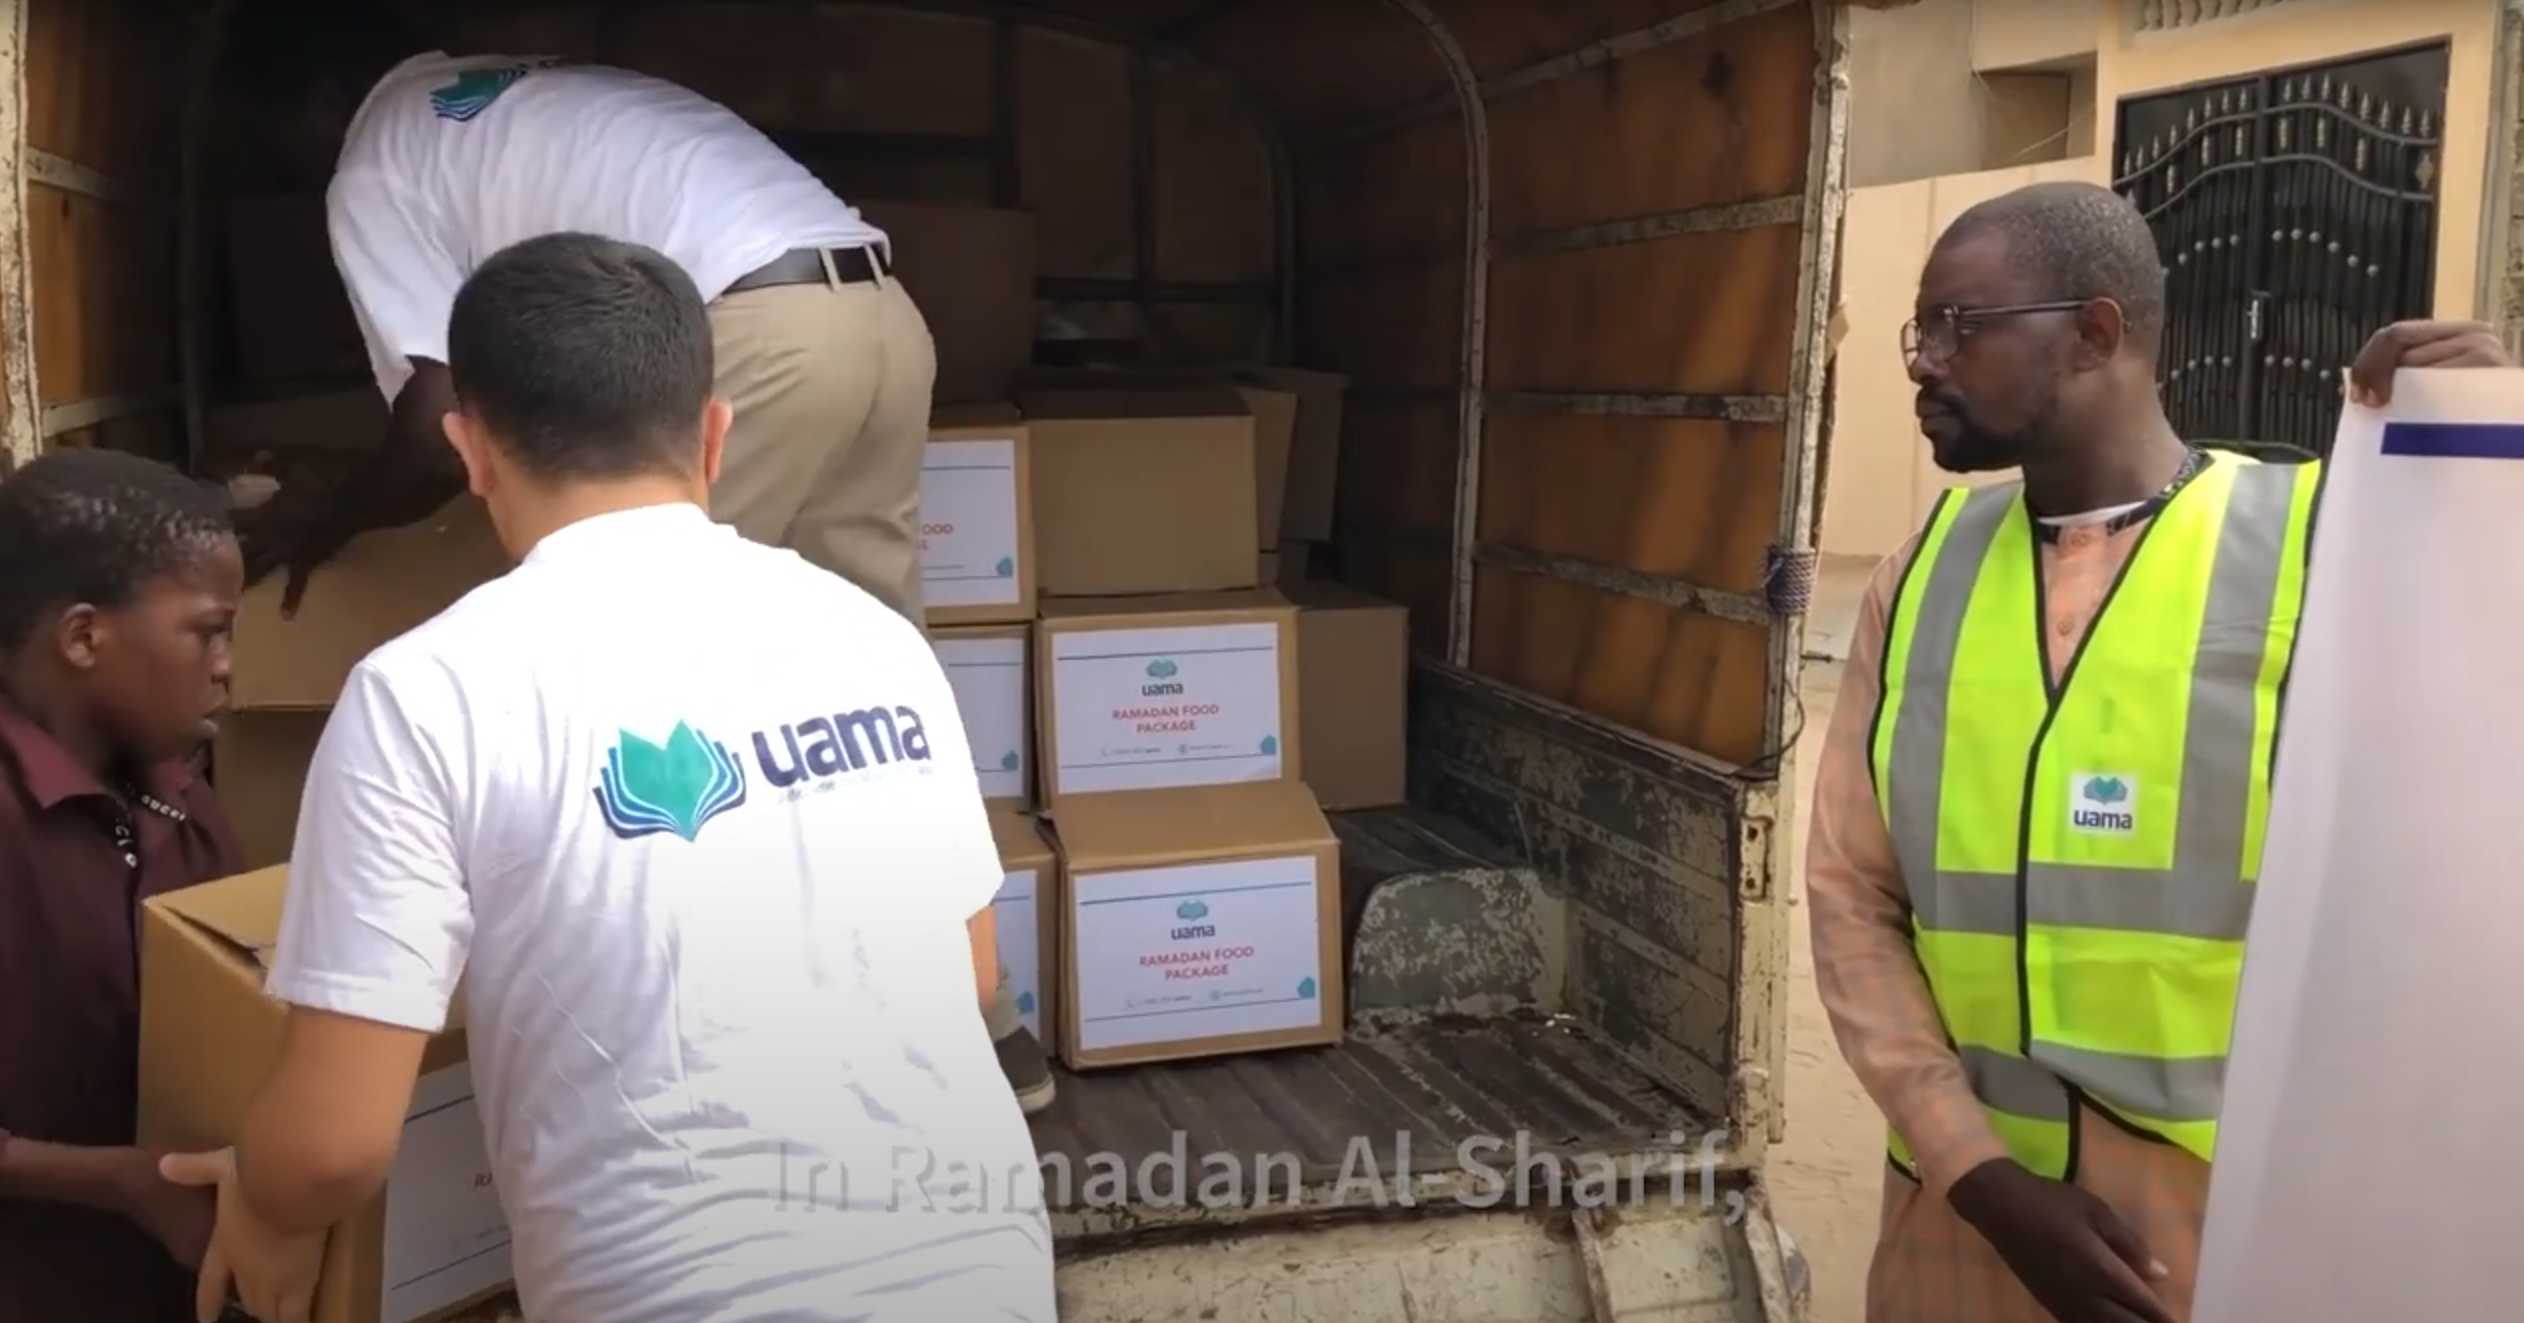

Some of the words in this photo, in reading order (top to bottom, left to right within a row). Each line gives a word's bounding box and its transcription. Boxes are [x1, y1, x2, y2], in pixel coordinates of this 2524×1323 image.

[921, 522, 954, 535] OOD
[1141, 683, 1184, 697] uama
[1112, 706, 1180, 721] RAMADAN
[1181, 703, 1220, 717] FOOD
[1135, 719, 1198, 734] PACKAGE
[751, 705, 932, 788] uama
[2073, 809, 2133, 831] uama
[1170, 924, 1216, 941] uama
[1139, 950, 1211, 968] RAMADAN
[1214, 945, 1255, 960] FOOD
[1164, 963, 1229, 981] PACKAGE
